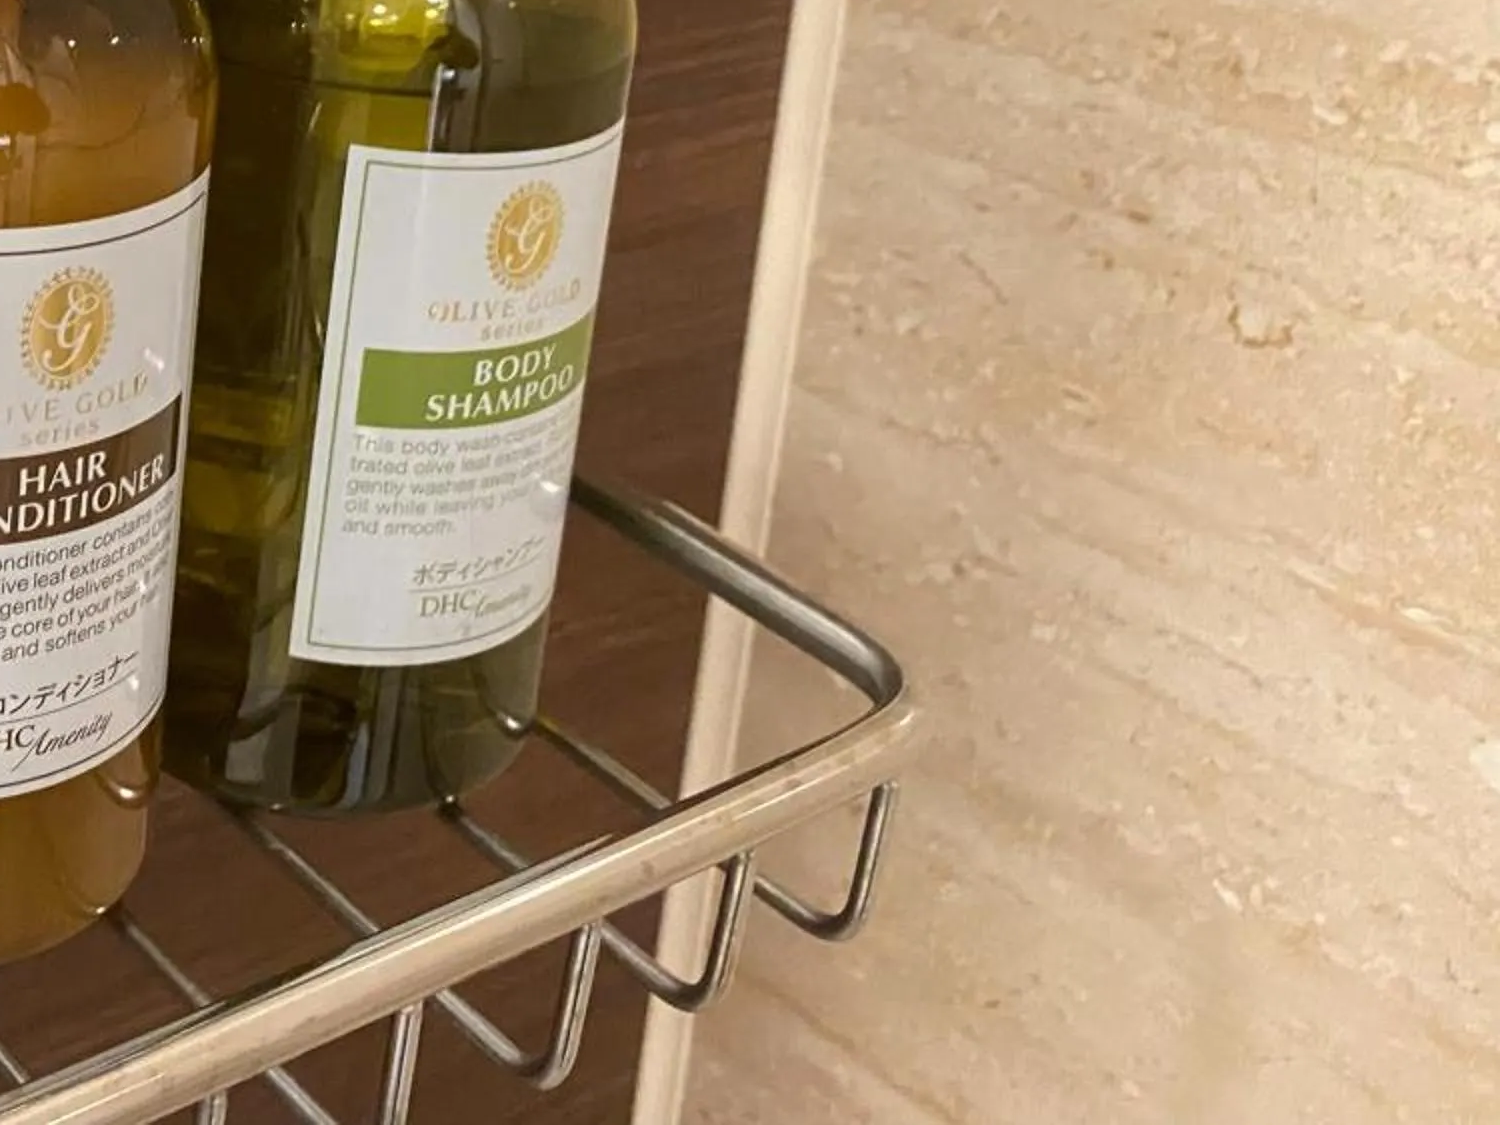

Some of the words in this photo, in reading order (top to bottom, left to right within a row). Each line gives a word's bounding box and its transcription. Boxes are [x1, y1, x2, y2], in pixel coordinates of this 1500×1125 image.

[474, 344, 556, 386] BODY
[75, 369, 148, 415] GOLD
[425, 364, 574, 422] SHAMPOO
[354, 433, 394, 454] This
[401, 439, 450, 458] body
[19, 450, 107, 497] HAIR
[33, 564, 67, 588] leaf
[69, 543, 126, 580] extract
[62, 568, 125, 604] delivers
[10, 617, 54, 639] core
[57, 606, 76, 628] of
[77, 596, 112, 626] your
[420, 589, 479, 618] DHC
[0, 639, 39, 663] and
[45, 619, 107, 653] softens
[108, 601, 139, 632] your
[11, 711, 114, 772] Amenity
